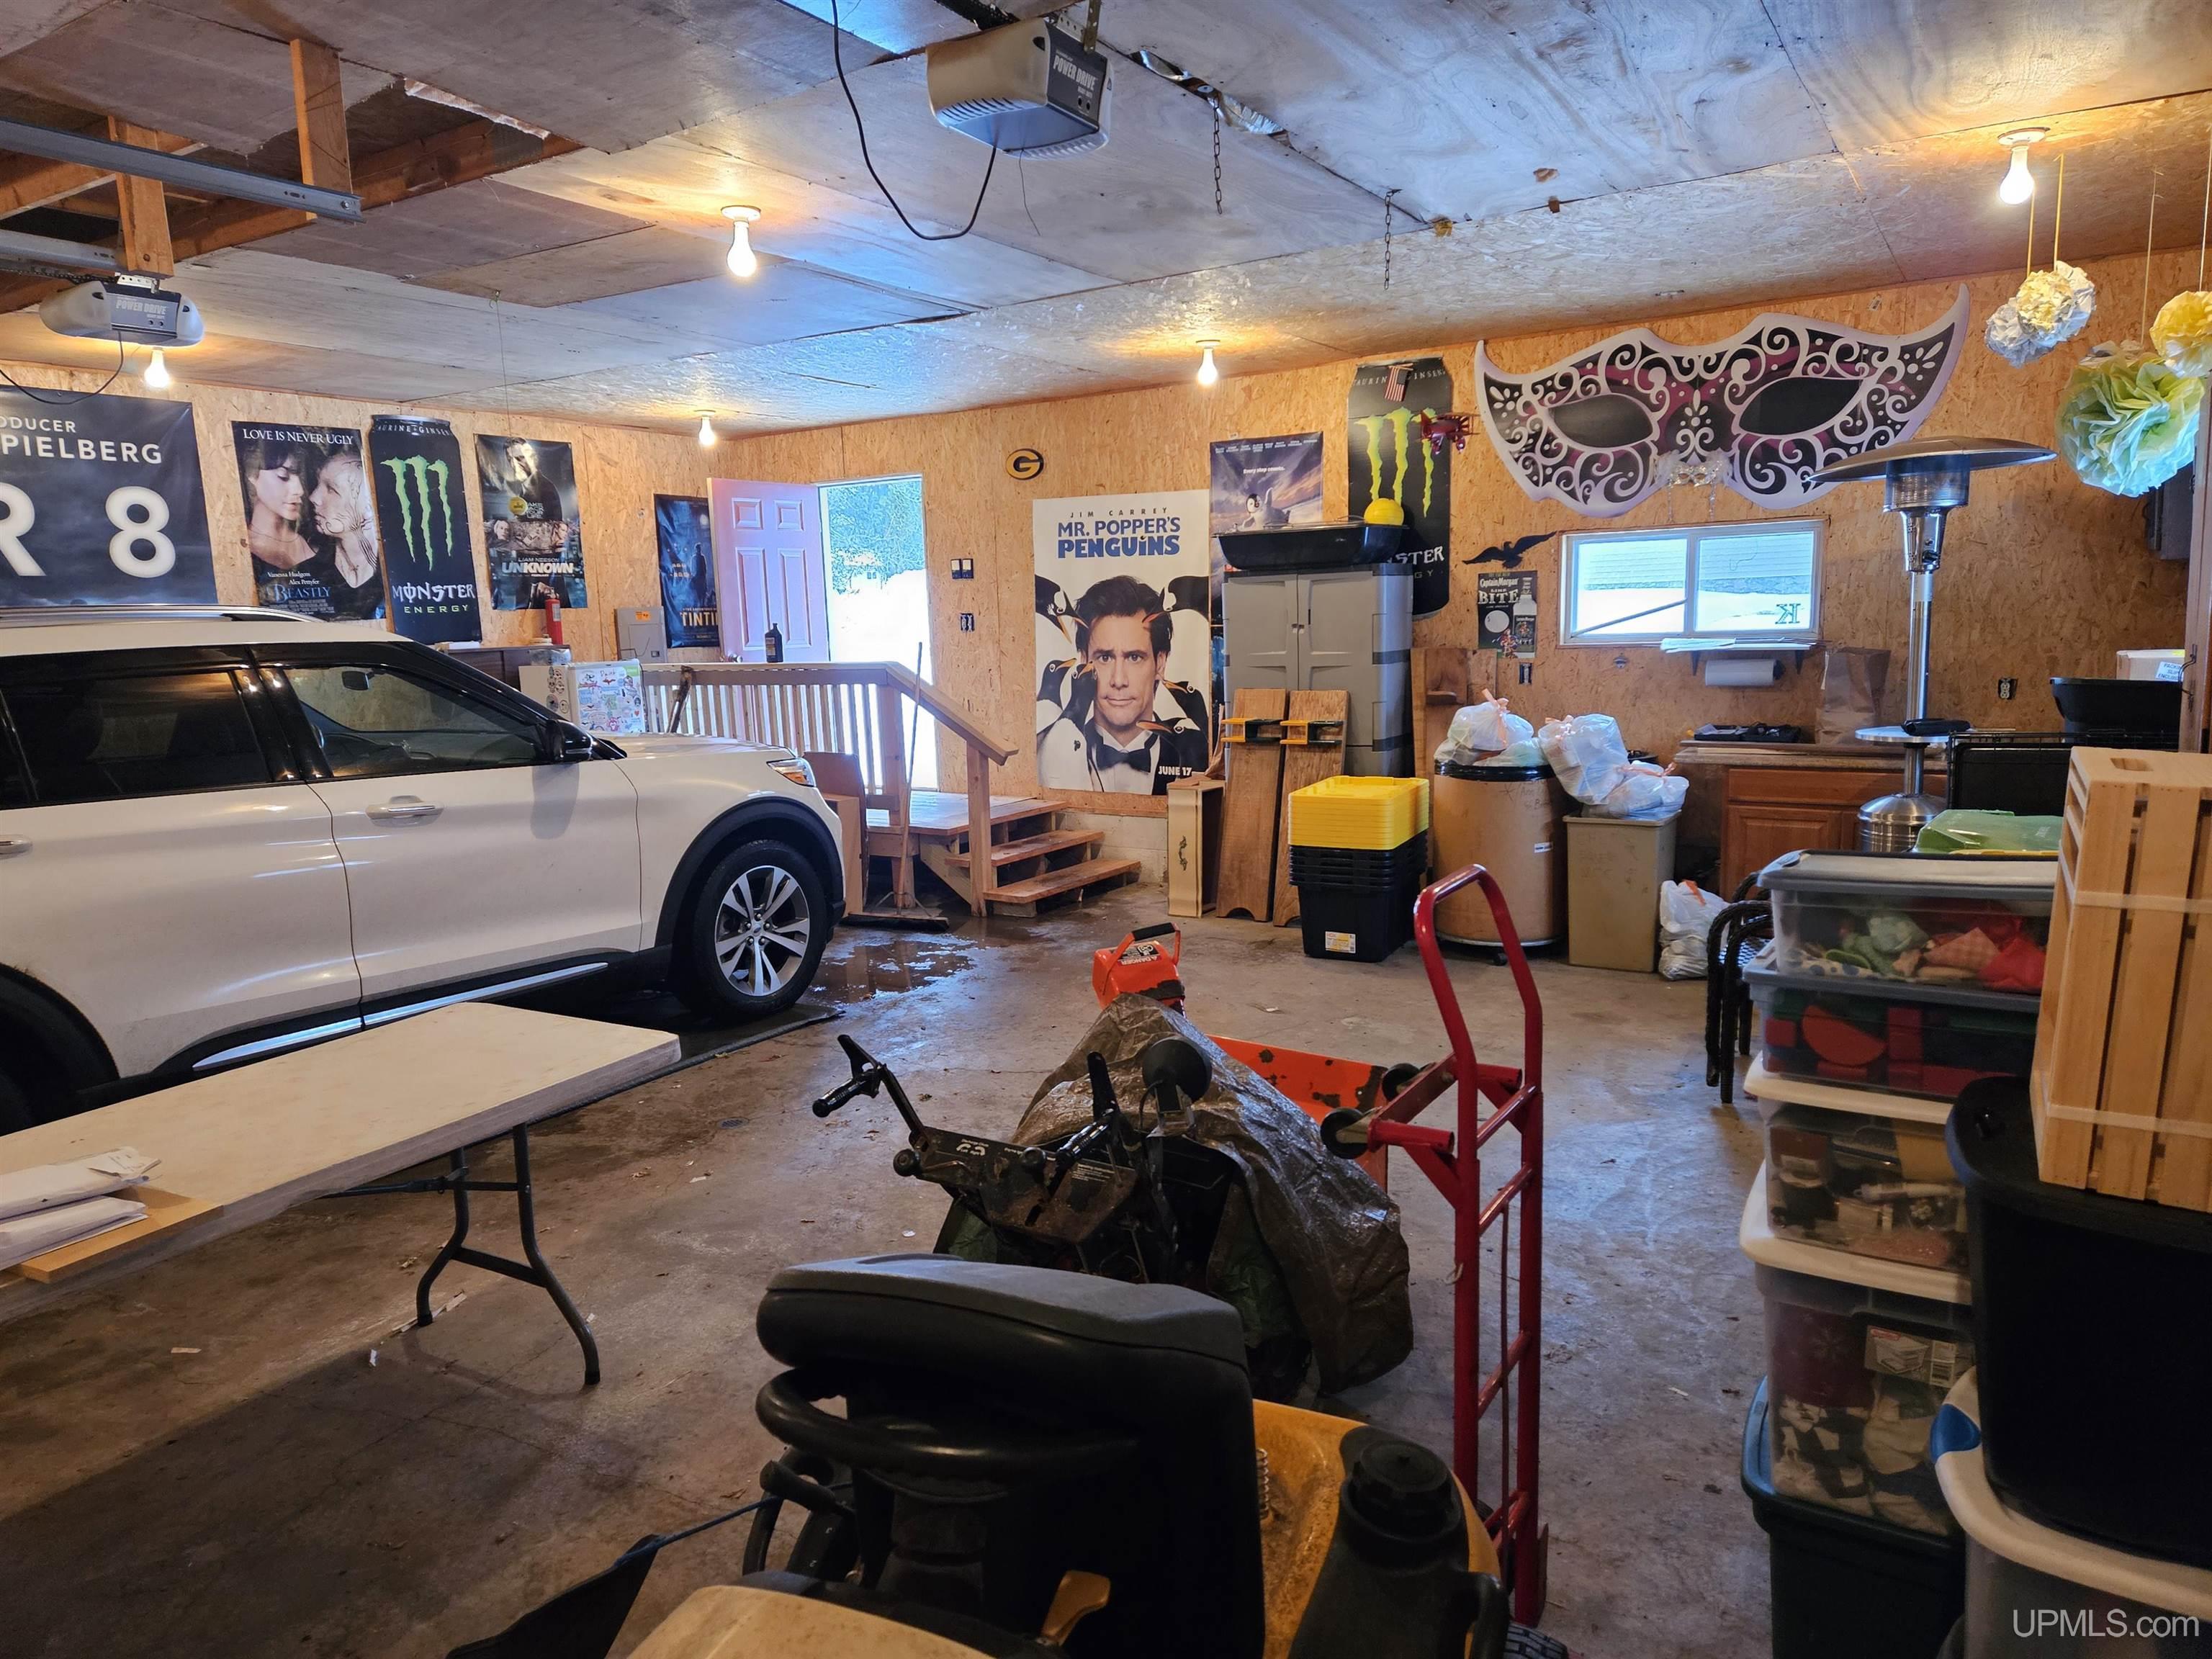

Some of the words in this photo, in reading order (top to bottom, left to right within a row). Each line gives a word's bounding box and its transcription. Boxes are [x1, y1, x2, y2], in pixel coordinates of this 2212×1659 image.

[1053, 55, 1077, 81] POWER
[1076, 68, 1096, 91] DRIVE
[116, 299, 143, 312] POWER
[143, 303, 166, 315] DRIVE
[0, 416, 76, 433] DUCER
[243, 428, 273, 440] LOVE
[275, 430, 285, 441] IS
[287, 431, 324, 444] NEVER
[326, 434, 354, 445] UGLY
[1, 434, 162, 464] PIELBERG
[1006, 448, 1044, 481] G
[1109, 508, 1167, 516] CARREY
[105, 485, 176, 578] 8
[1058, 521, 1090, 537] MR.
[1094, 516, 1181, 536] POPPER'S
[502, 562, 574, 573] UNKNOWN
[1480, 578, 1498, 588] Captain
[1498, 577, 1519, 587] Morgan
[273, 583, 331, 603] BEASTLY
[392, 582, 475, 603] MONSTER
[1478, 589, 1519, 605] BITE
[404, 605, 468, 613] ENERGY
[1158, 765, 1181, 776] JUNE
[1182, 766, 1192, 776] 17
